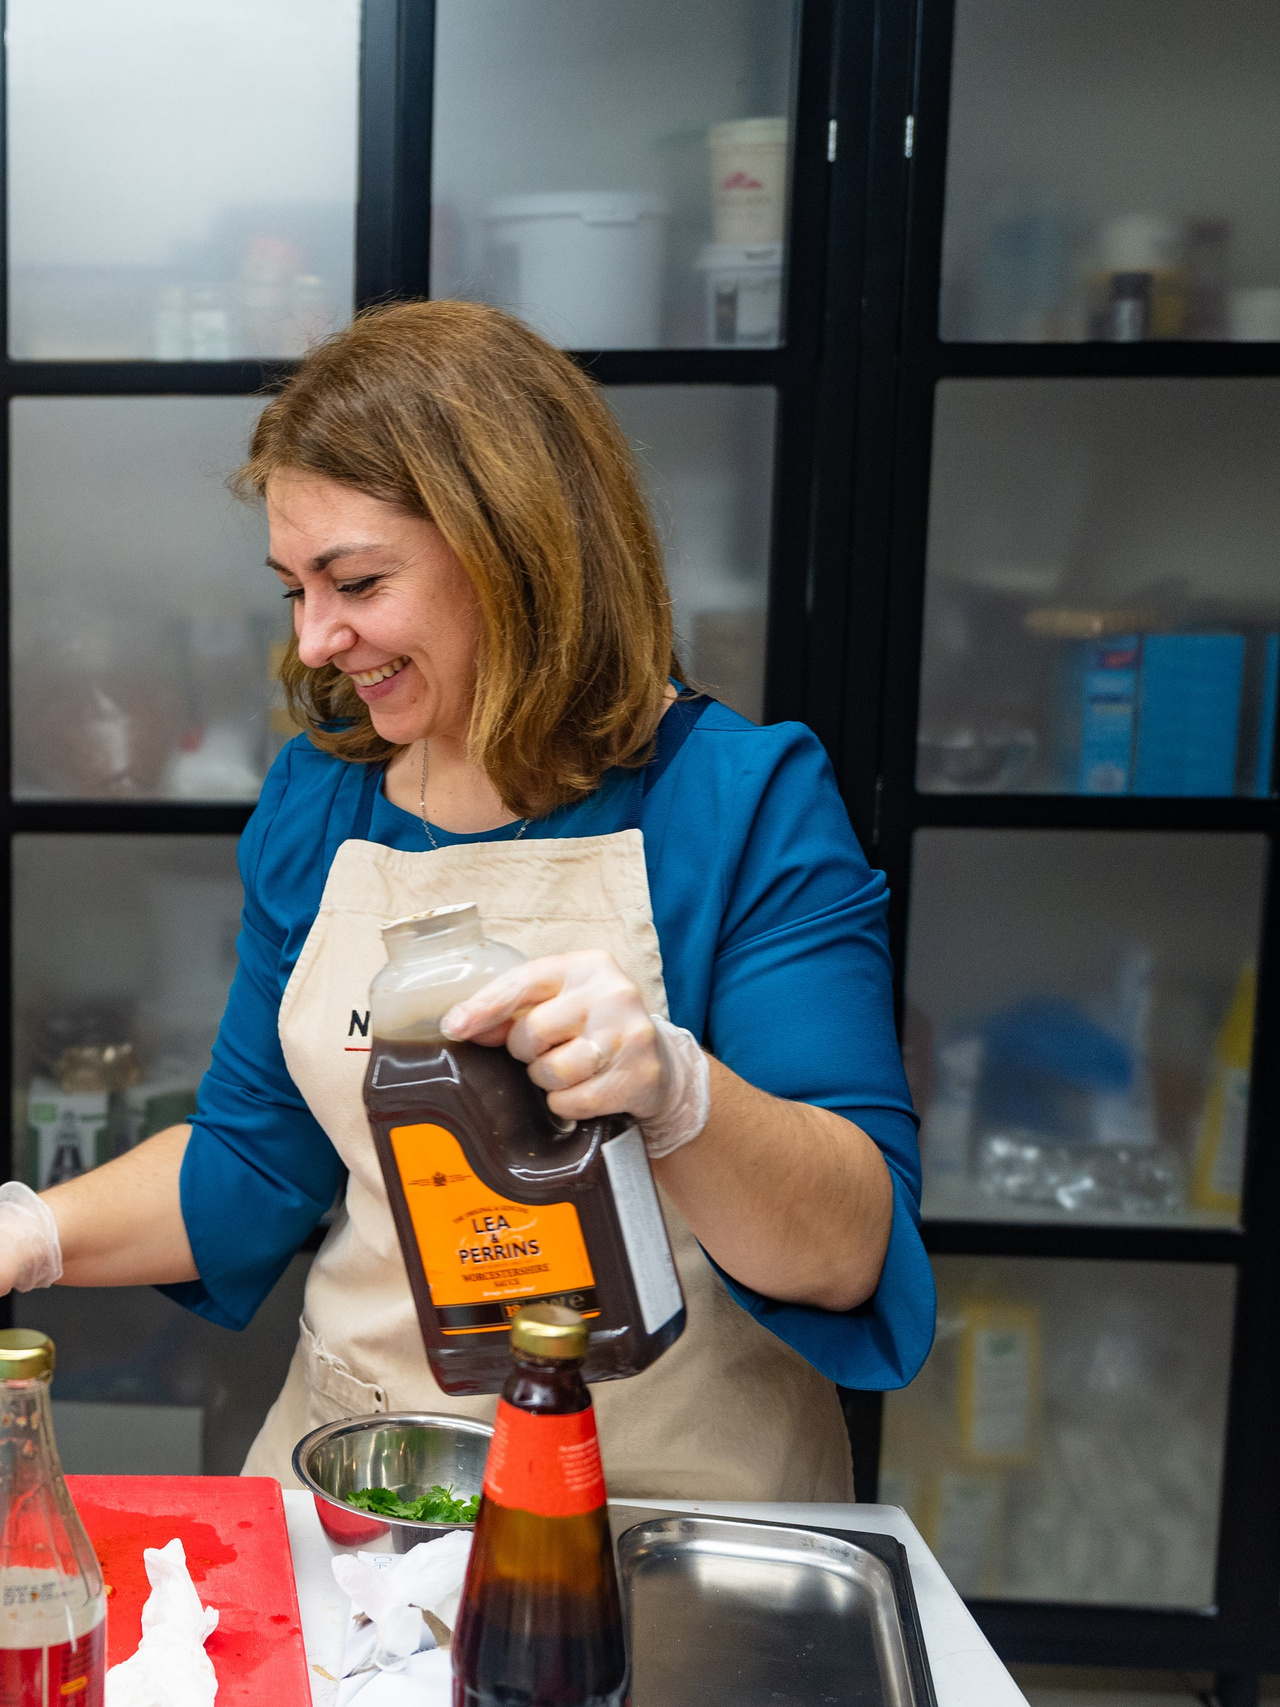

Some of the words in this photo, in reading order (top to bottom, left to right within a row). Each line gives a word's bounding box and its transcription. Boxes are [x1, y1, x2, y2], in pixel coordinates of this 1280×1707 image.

[471, 1214, 512, 1234] LEA
[491, 1233, 500, 1244] &
[458, 1239, 541, 1265] PERRINS
[461, 1262, 551, 1283] WORCESTERSHIRE
